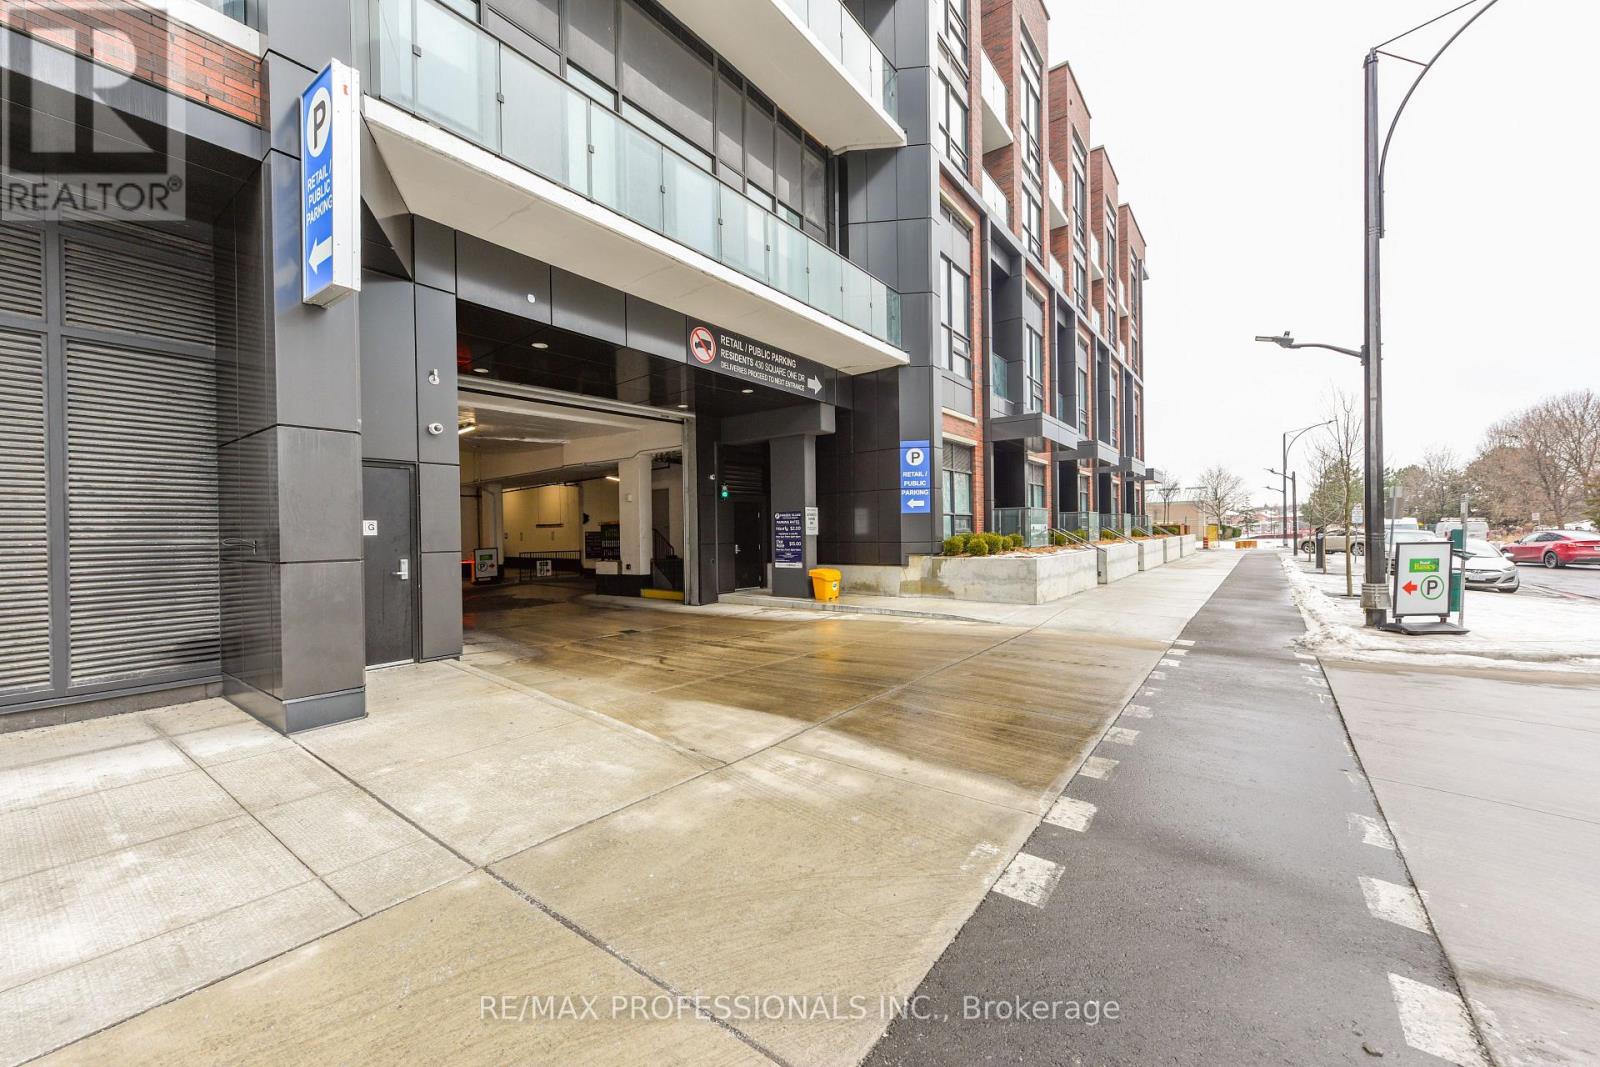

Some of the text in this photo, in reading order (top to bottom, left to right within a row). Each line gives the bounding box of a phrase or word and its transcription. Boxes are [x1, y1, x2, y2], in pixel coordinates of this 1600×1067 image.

[313, 99, 326, 150] P
[307, 163, 328, 193] RETAIL
[308, 178, 330, 208] PUBLIC
[306, 194, 333, 227] PARKING
[720, 334, 744, 352] RETAIL
[749, 344, 771, 359] PUBLIC
[771, 352, 797, 368] PARKING
[720, 348, 805, 381] RESIDENTS 430 SQUARE ONE DR
[720, 361, 805, 392] DELIVERIES PROCEED TO NEXT ENTRANCE
[911, 452, 920, 463] P
[1427, 580, 1438, 595] P
